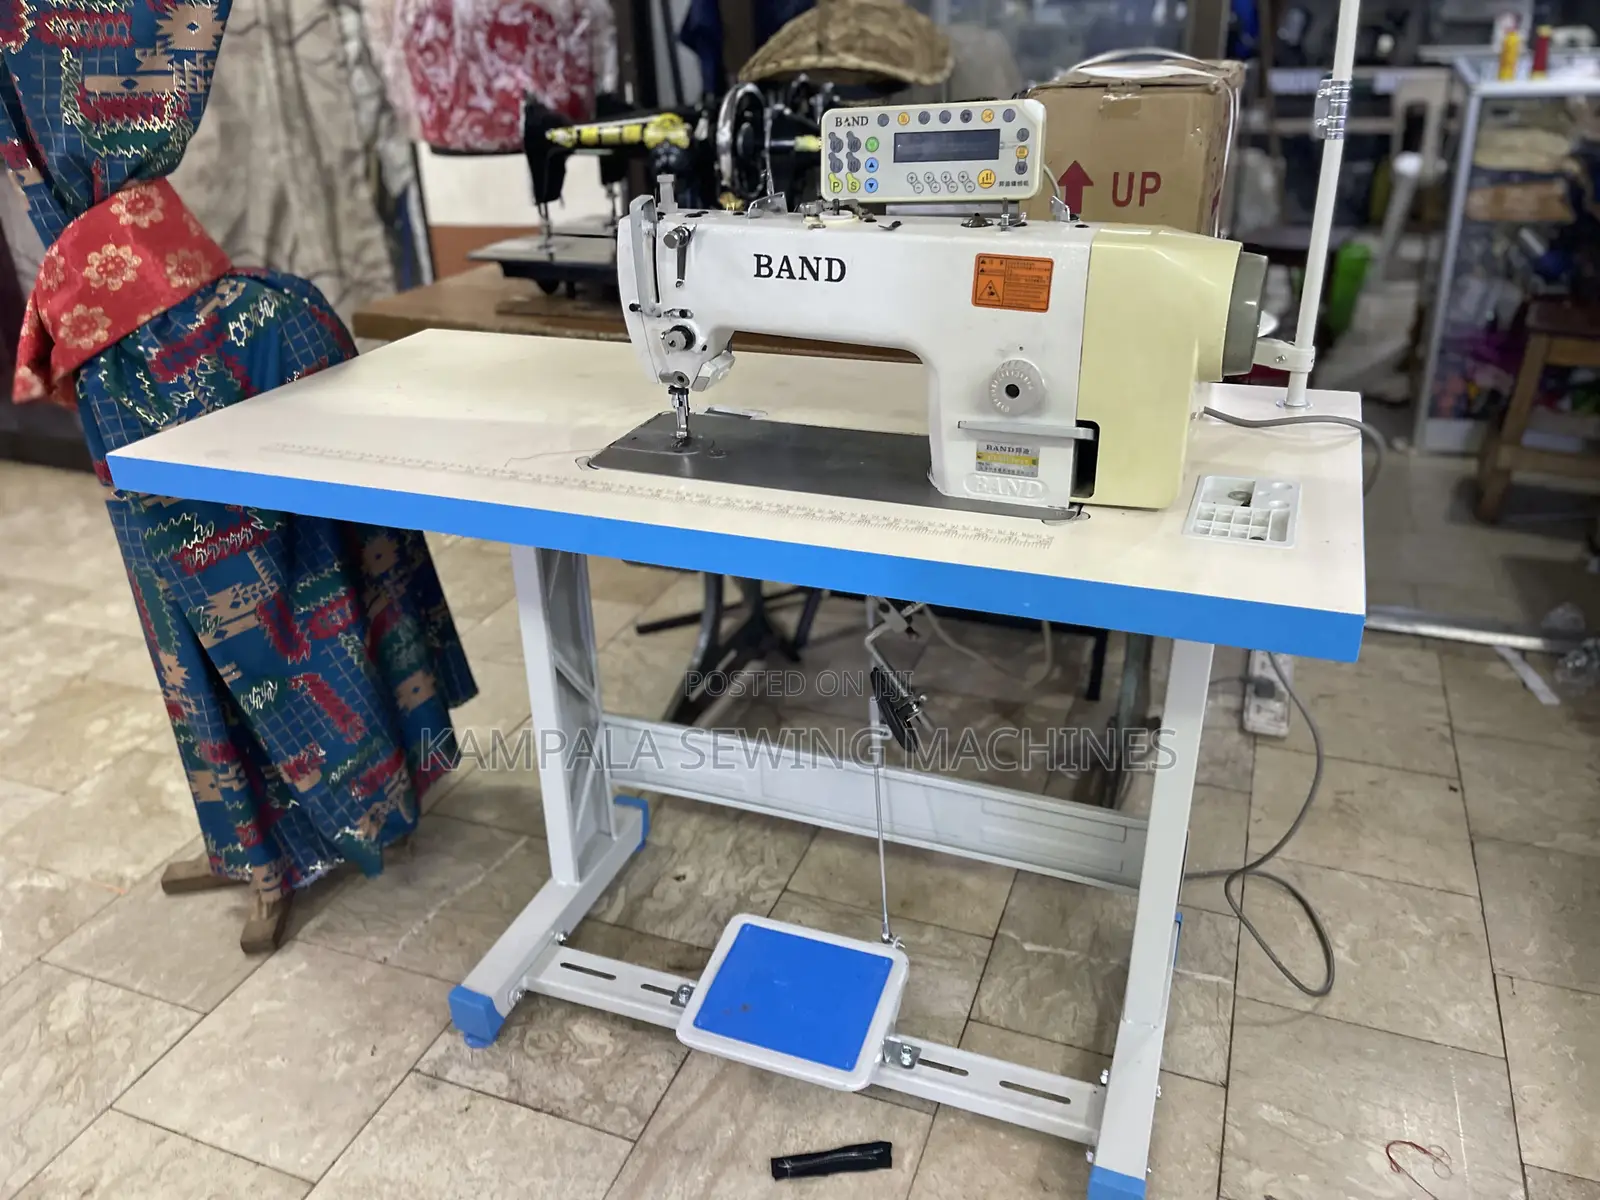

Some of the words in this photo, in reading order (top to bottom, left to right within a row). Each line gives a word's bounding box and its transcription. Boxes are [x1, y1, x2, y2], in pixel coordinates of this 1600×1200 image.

[835, 116, 869, 127] BAND
[833, 182, 840, 192] P
[850, 181, 858, 191] S
[1112, 171, 1162, 208] UP
[753, 253, 847, 283] BAND
[976, 476, 1043, 499] BAND
